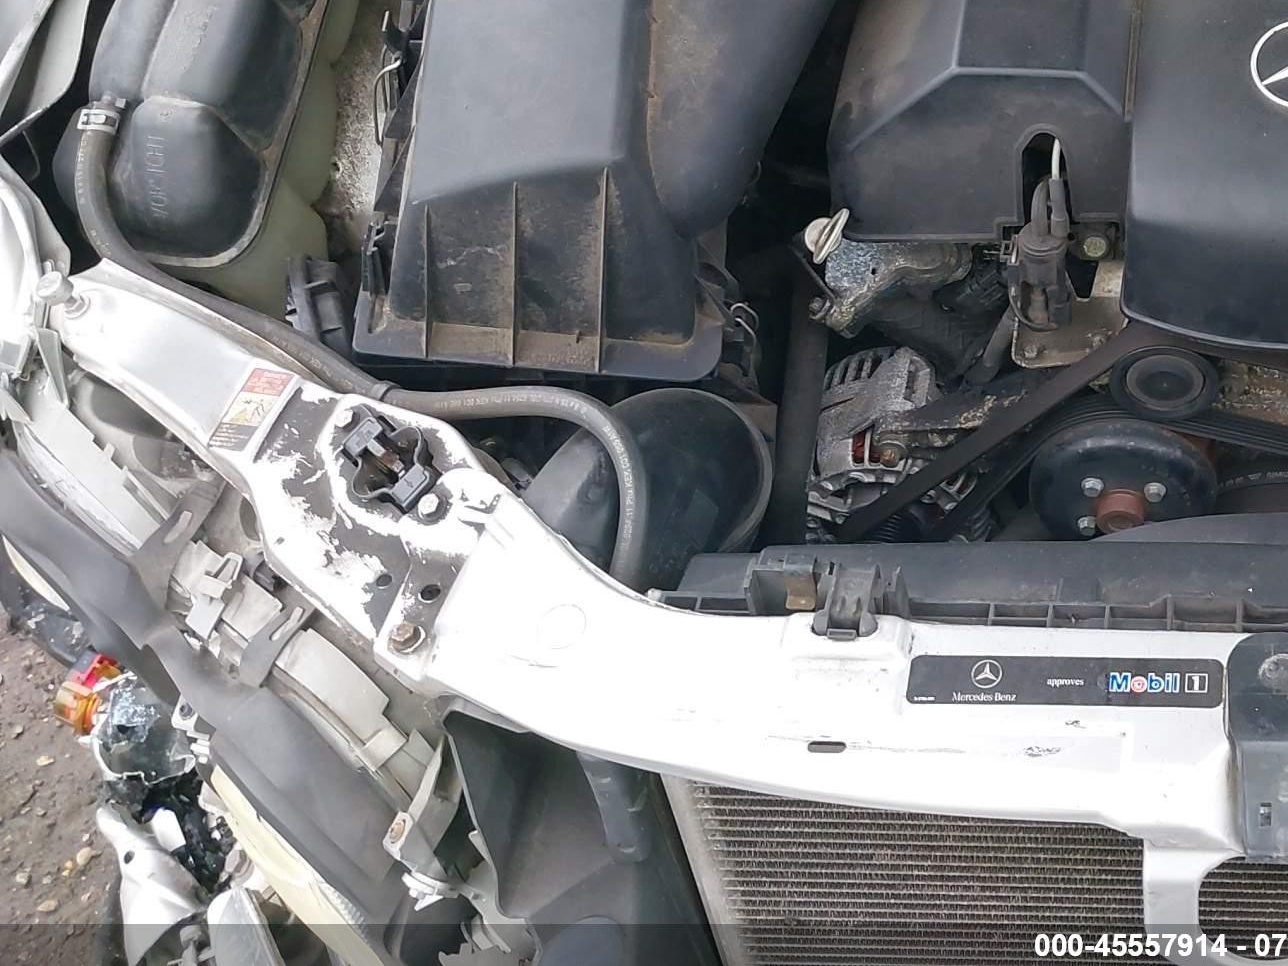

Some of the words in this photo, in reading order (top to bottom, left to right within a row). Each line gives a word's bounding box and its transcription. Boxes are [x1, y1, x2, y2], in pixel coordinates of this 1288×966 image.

[1046, 677, 1084, 687] approves
[1108, 672, 1180, 693] Mobil
[951, 691, 993, 702] Mercedes
[994, 692, 1016, 702] Benz
